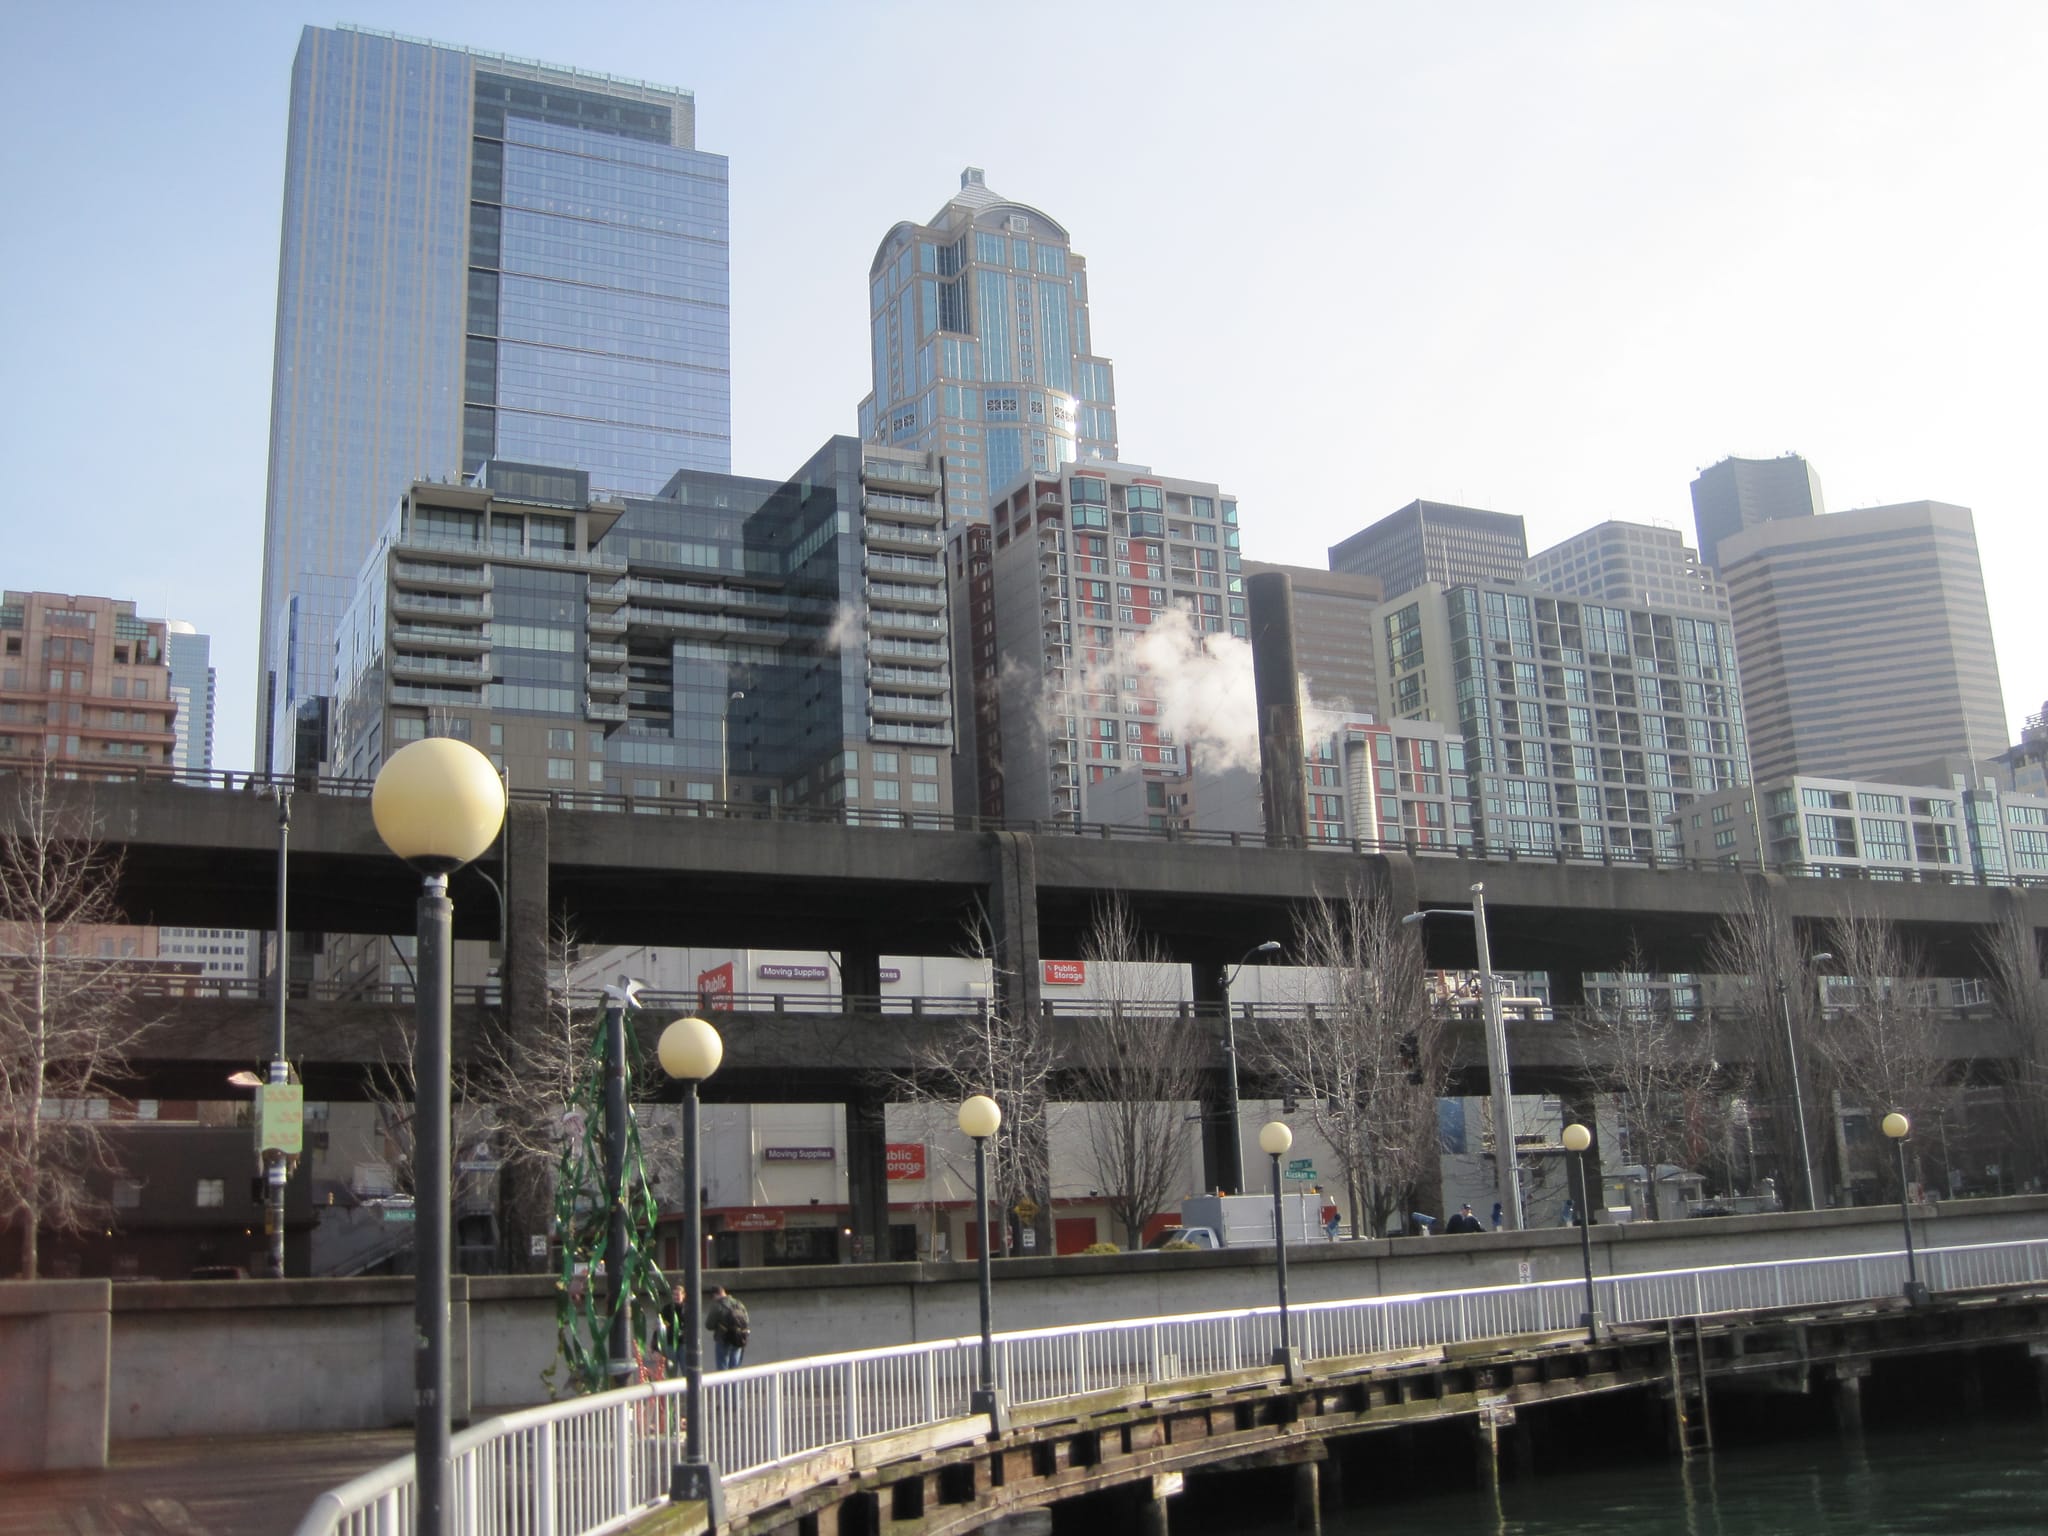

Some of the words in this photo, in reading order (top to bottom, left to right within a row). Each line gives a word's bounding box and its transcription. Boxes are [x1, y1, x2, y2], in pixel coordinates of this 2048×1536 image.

[764, 967, 793, 978] Moving
[794, 968, 825, 978] Supplies
[1054, 964, 1078, 972] Public
[1054, 972, 1083, 981] Storage
[705, 974, 727, 993] Public
[768, 1150, 798, 1159] Moving
[799, 1150, 831, 1159] Supplies
[887, 1162, 921, 1174] orage
